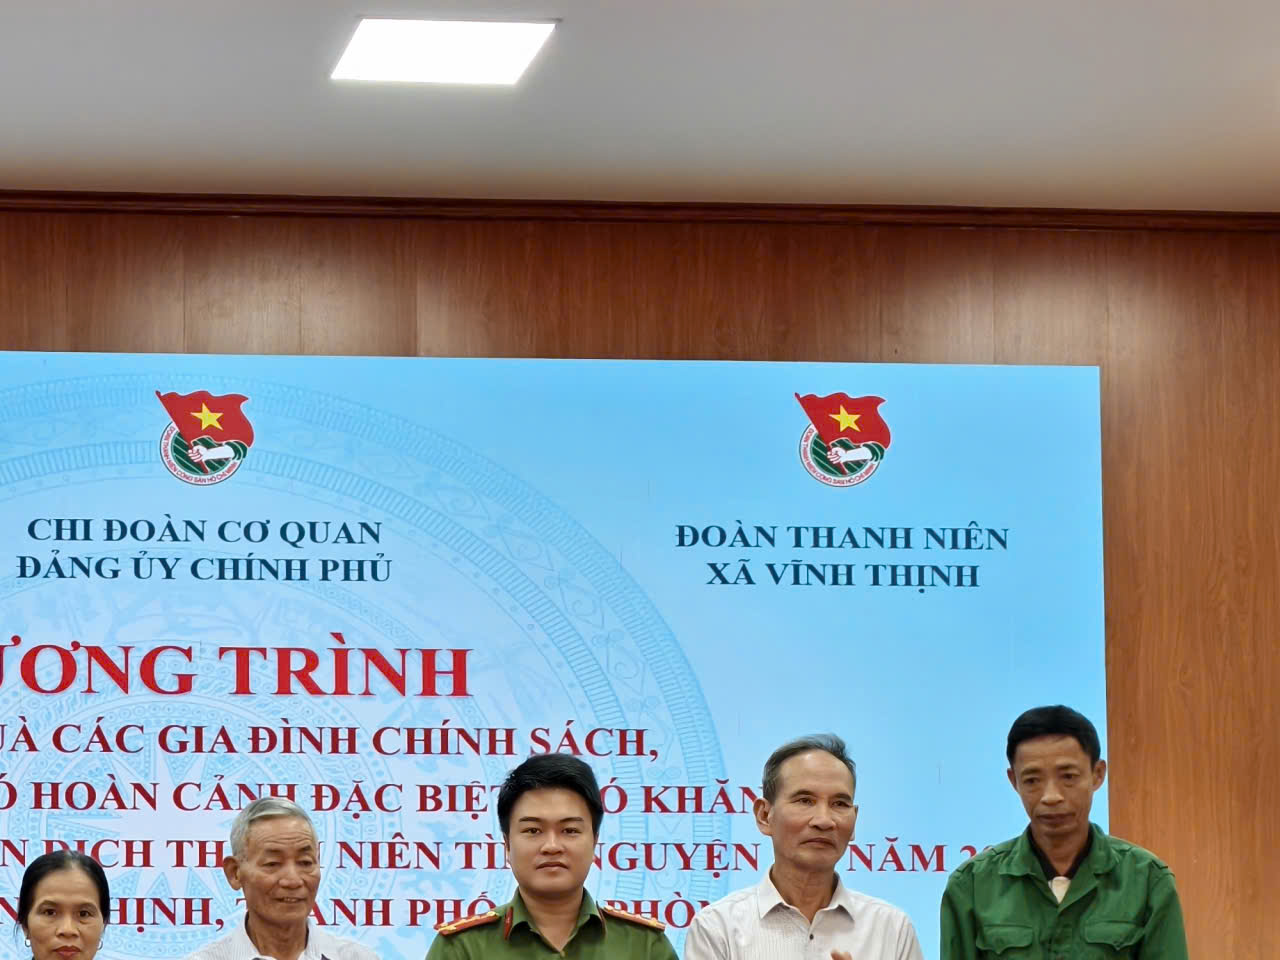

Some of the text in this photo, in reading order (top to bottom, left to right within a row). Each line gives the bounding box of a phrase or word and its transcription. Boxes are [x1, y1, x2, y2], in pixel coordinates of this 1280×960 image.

[28, 514, 382, 548] CHI ĐOÀN CƠ QUAN
[675, 520, 1009, 550] ĐOÀN THANH NIÊN
[16, 549, 393, 581] ĐẢNG ỦY CHÍNH PHỦ
[706, 558, 980, 593] XÃ VĨNH THỊNH
[218, 632, 472, 699] TRÌNH
[51, 717, 145, 755] CÁC
[157, 726, 237, 755] GIA
[249, 718, 358, 756] ĐÌNH
[371, 719, 516, 758] CHÍNH
[529, 720, 659, 762] SÁCH,
[32, 774, 159, 811] HOÀN
[311, 780, 404, 820] ĐẶC
[416, 781, 501, 820] BIỆ
[337, 832, 443, 870] NIÊN
[847, 836, 949, 872] NĂM
[107, 896, 224, 934] HỊNH,
